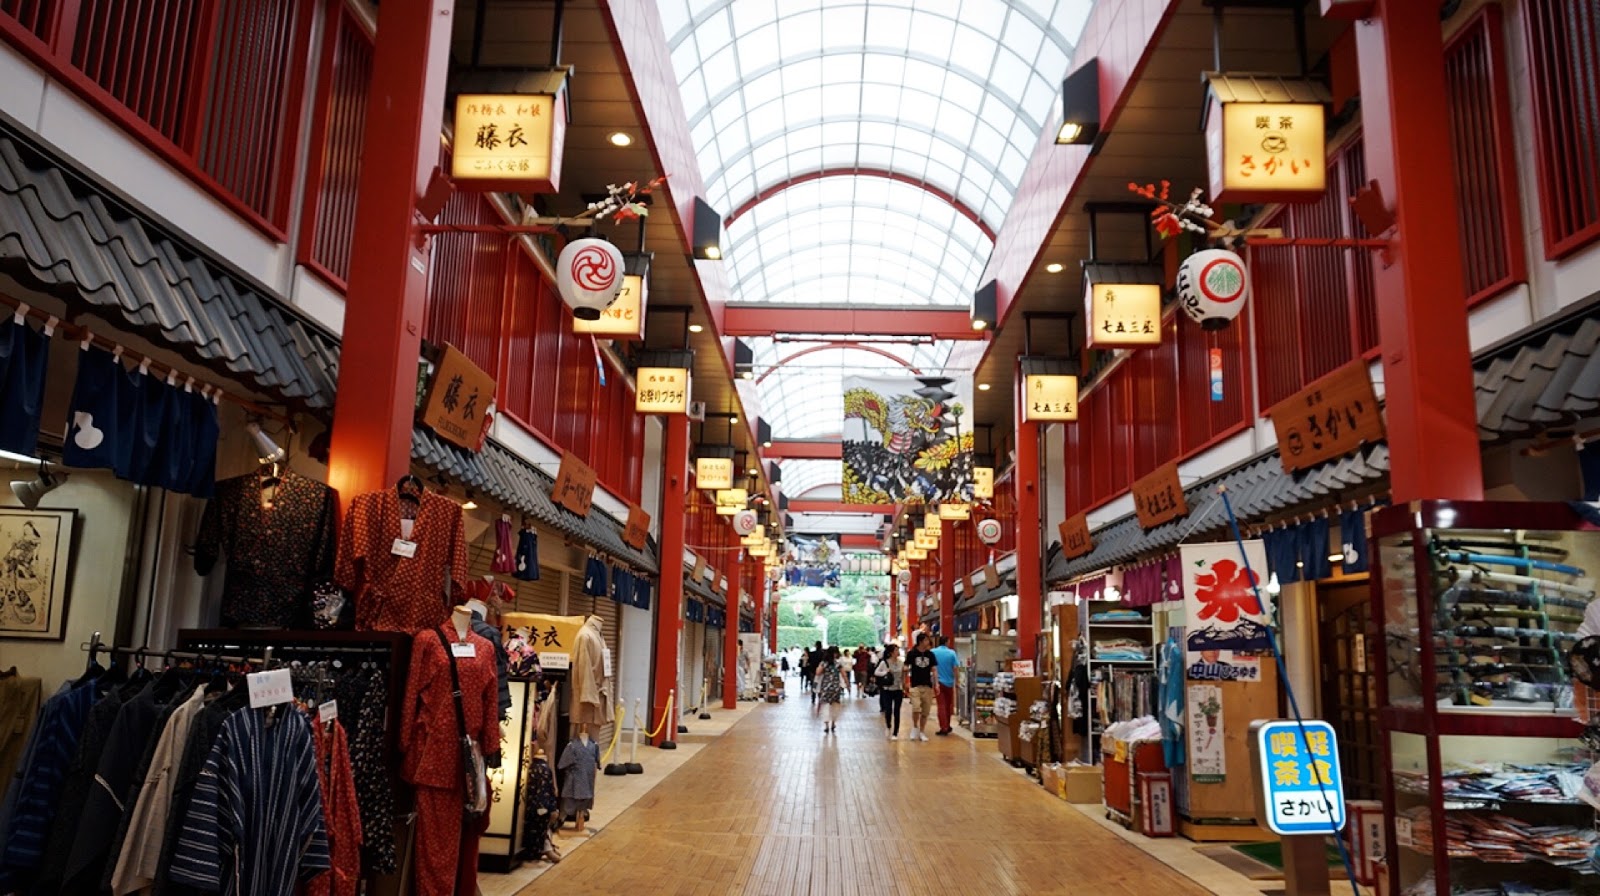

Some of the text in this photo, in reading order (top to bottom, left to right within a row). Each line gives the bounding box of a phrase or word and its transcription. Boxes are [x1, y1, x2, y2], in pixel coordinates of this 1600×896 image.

[1255, 116, 1293, 129] 喫茶
[475, 123, 528, 150] 藤衣
[1240, 154, 1311, 177] さかい
[1102, 320, 1155, 334] 七五三屋
[443, 374, 479, 420] 藤衣
[1033, 402, 1072, 413] 七五三屋
[1308, 401, 1363, 450] さかい
[1194, 559, 1261, 623] 氷
[1190, 664, 1257, 678] 中山ひろゆき
[1280, 799, 1334, 816] さかい
